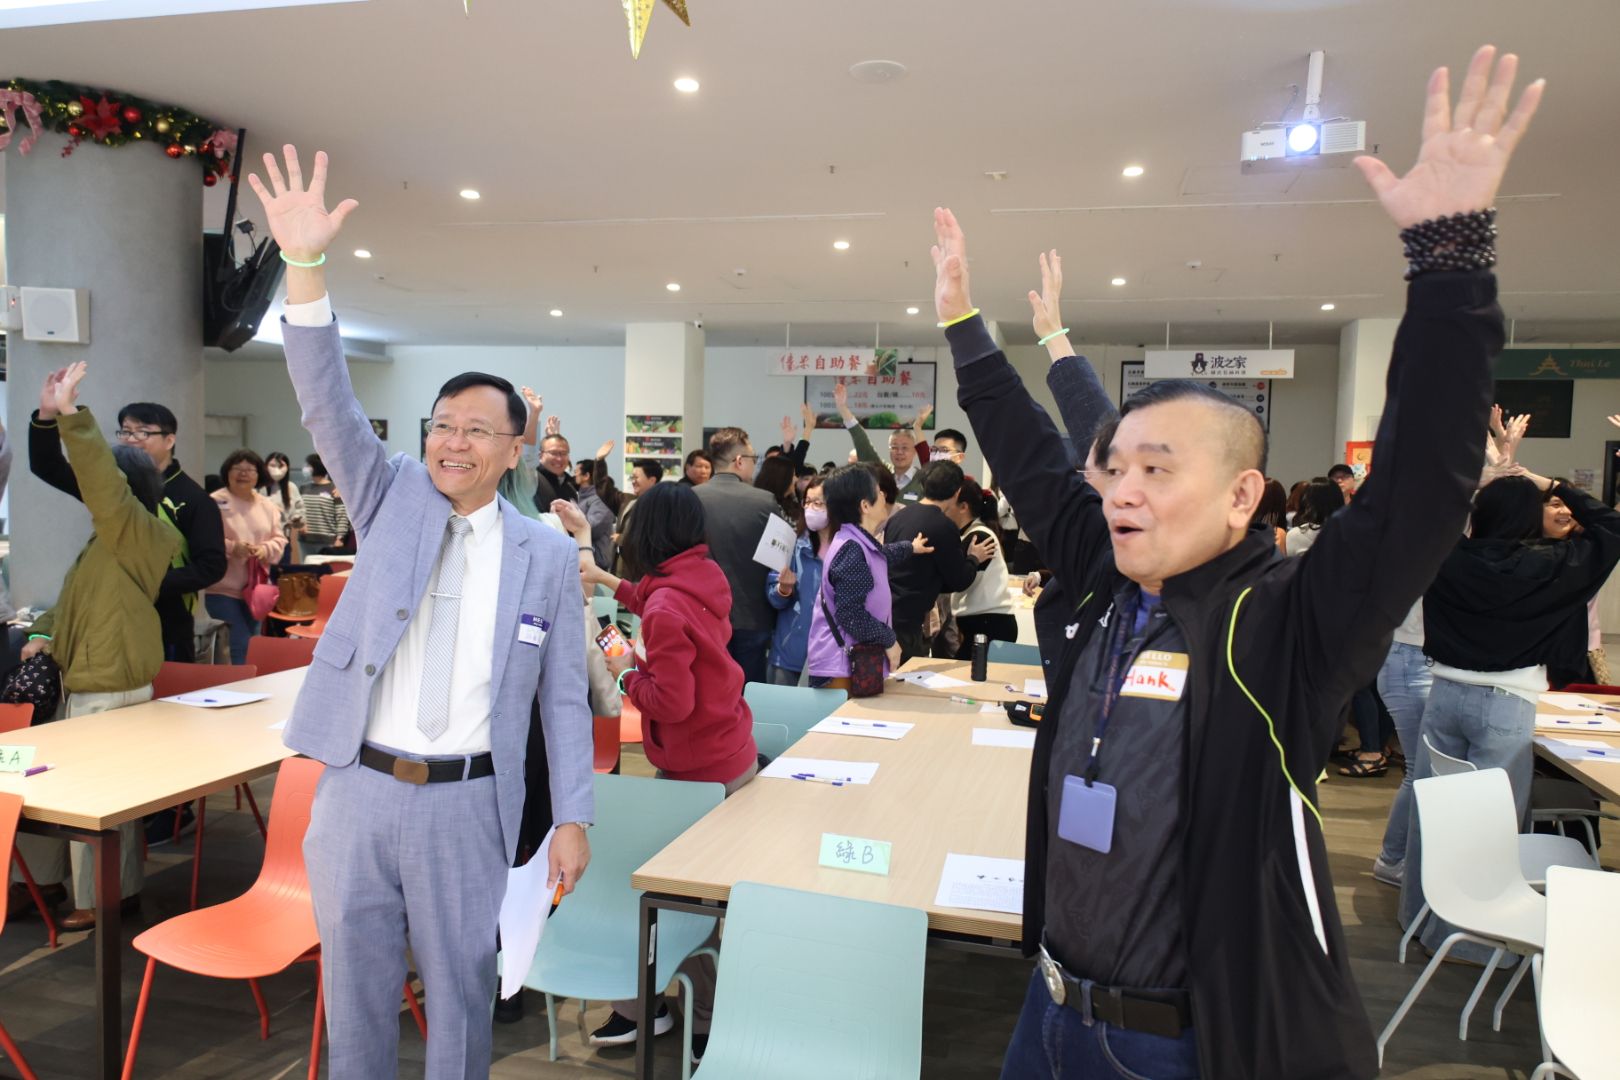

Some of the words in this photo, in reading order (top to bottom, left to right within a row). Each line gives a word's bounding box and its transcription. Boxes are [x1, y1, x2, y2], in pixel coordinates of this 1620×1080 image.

[1210, 355, 1247, 369] 波之家
[1123, 669, 1176, 692] Hank
[861, 845, 874, 865] B
